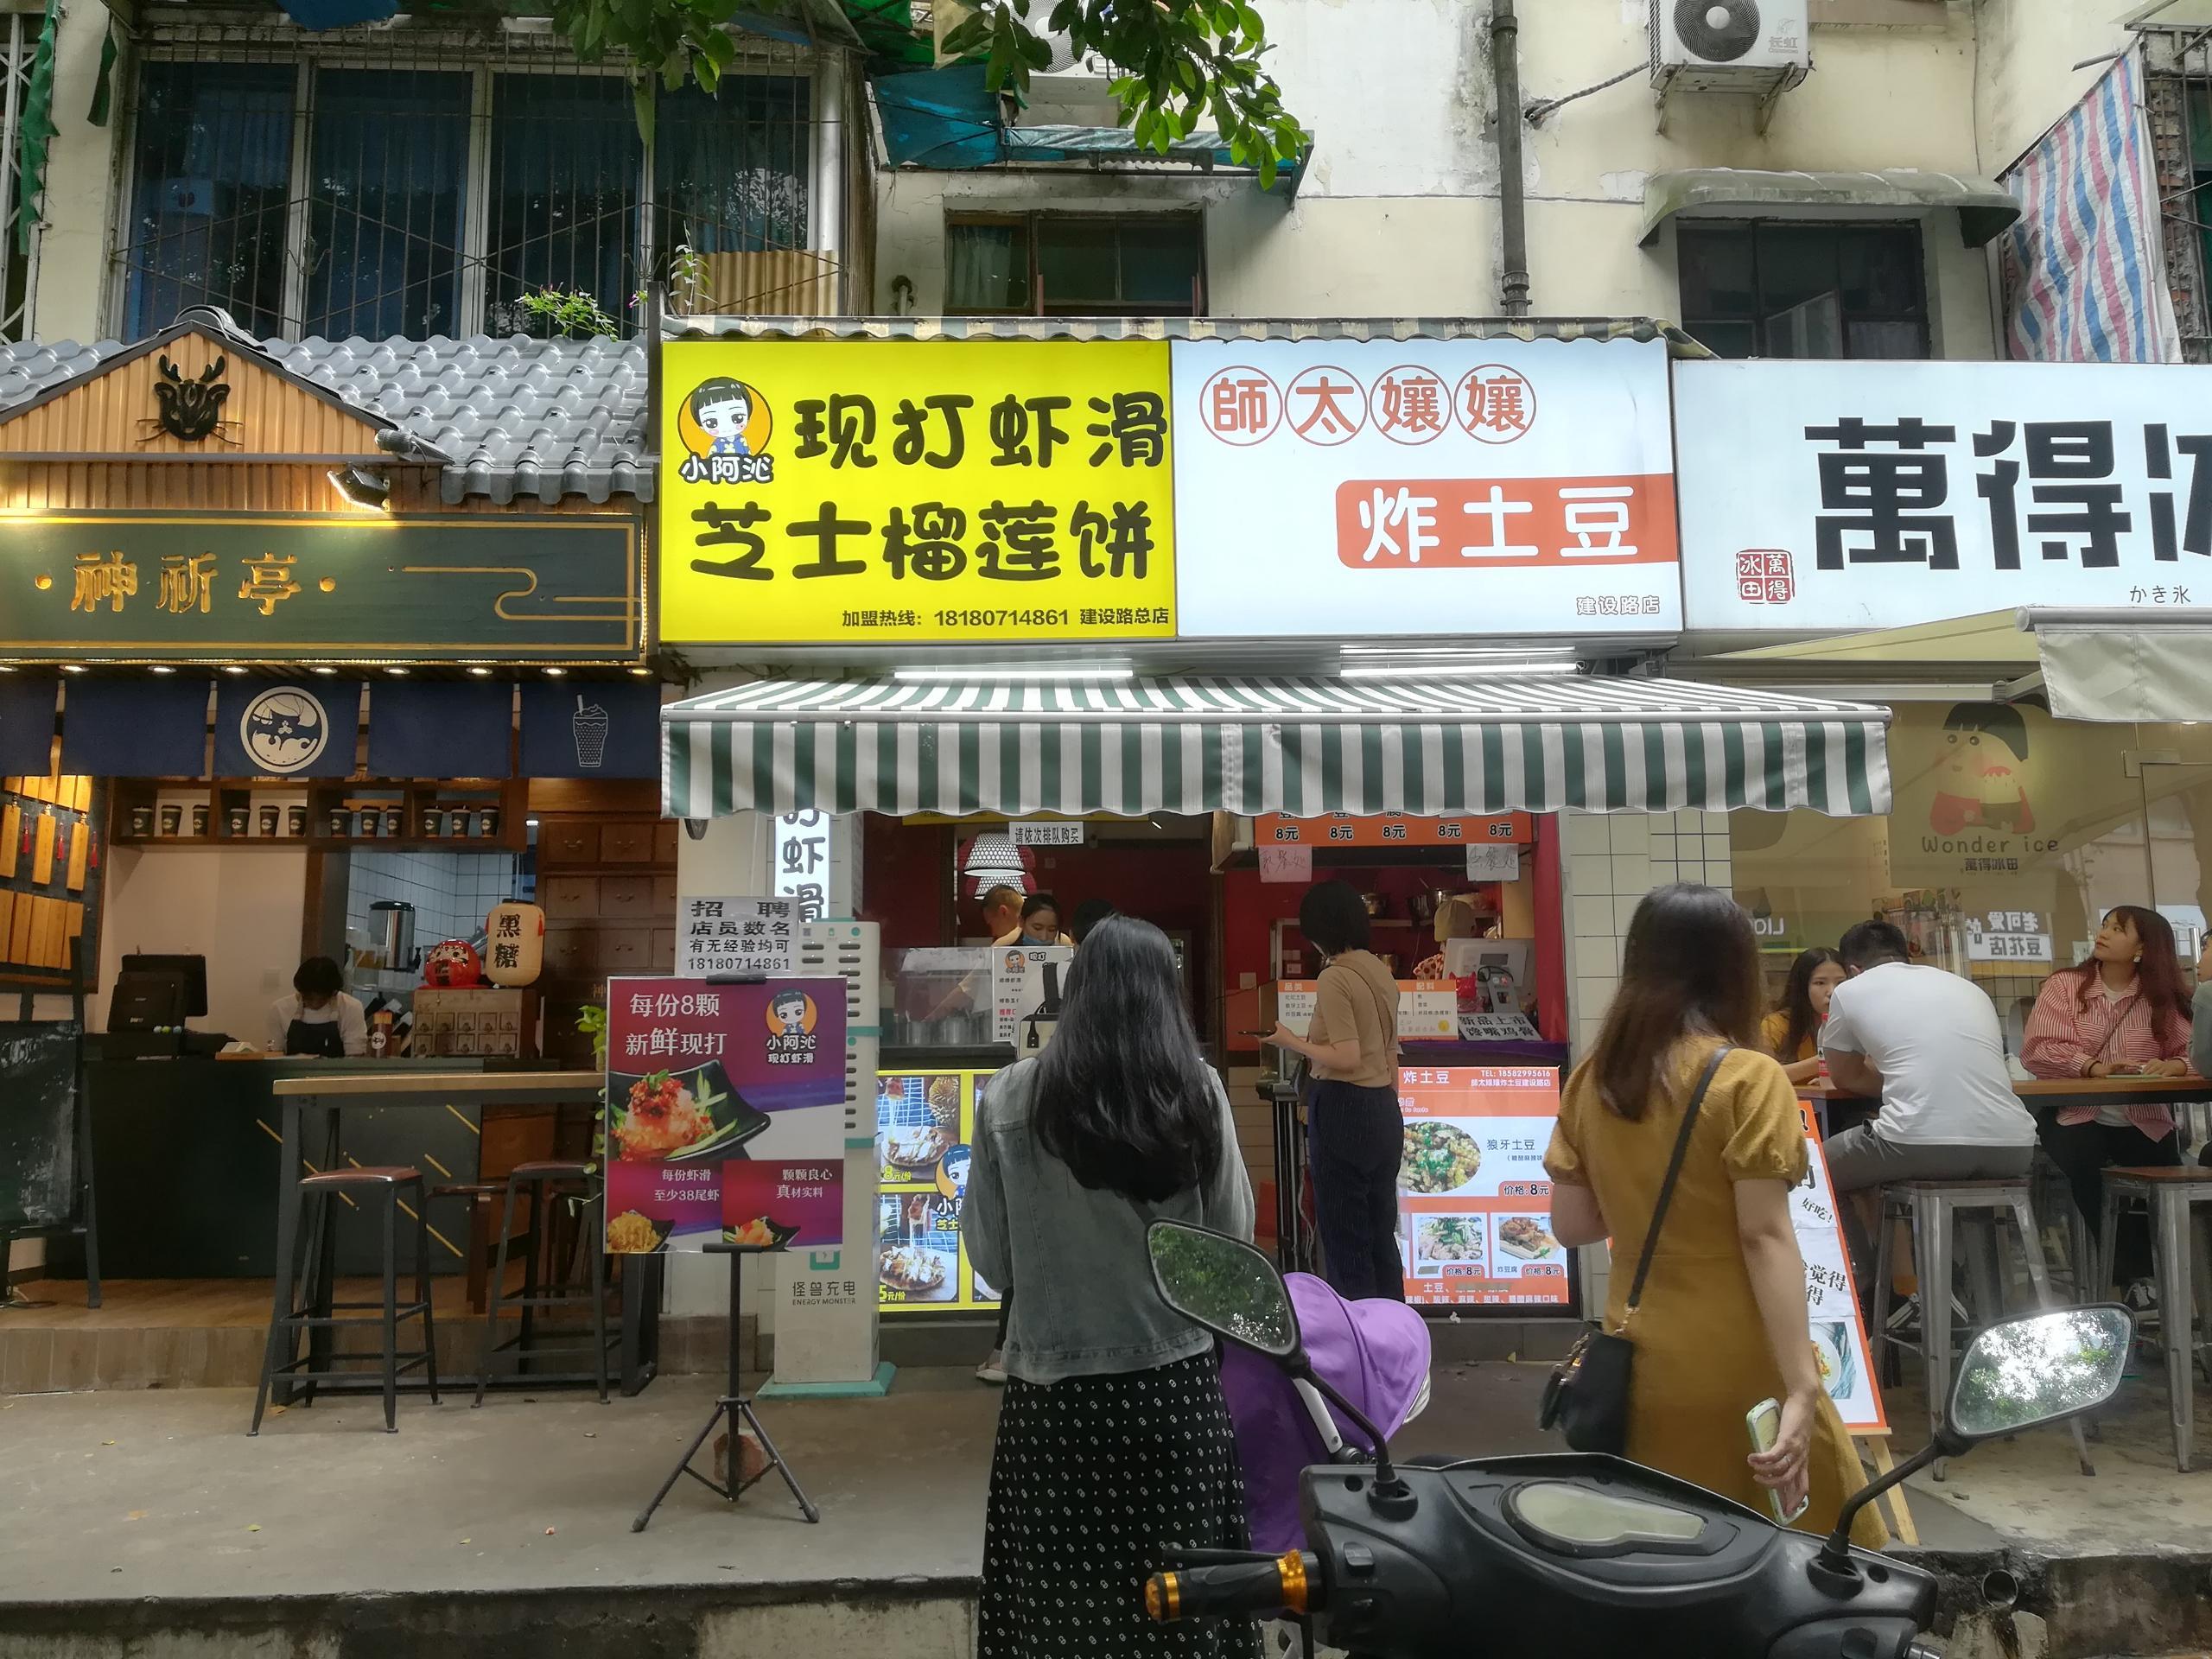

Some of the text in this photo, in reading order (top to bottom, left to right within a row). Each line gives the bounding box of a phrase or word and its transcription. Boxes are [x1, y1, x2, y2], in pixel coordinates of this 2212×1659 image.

[1212, 375, 1527, 434] 師太孃孃
[793, 391, 1167, 469] 现打虾滑
[680, 454, 773, 483] 小阿沁
[1359, 486, 1637, 563] 炸土豆
[690, 499, 1155, 581] 芝士榴莲饼
[71, 550, 301, 616] 神祈亭
[1577, 595, 1660, 615] 建设路店
[842, 607, 1170, 627] 加盟热线： 18180714861 建设路总店
[1015, 827, 1079, 843] 请依次排队购买
[1275, 827, 1299, 840] 8元
[1330, 826, 1353, 839] 8元
[1383, 825, 1406, 839] 8元
[1438, 824, 1461, 837] 8元
[1490, 823, 1512, 837] 8元
[1922, 836, 2059, 853] Wonder ice
[690, 921, 791, 936] 店员数名
[690, 938, 790, 953] 有无经验均可
[688, 957, 790, 970] 18180714861
[630, 993, 721, 1018] 每份8颗
[626, 1027, 728, 1056] 新鲜现打
[766, 1034, 817, 1051] 小阿沁
[1403, 1070, 1450, 1084] 炸土豆
[1498, 1069, 1551, 1077] 18582995616
[1486, 1139, 1535, 1151] 狼牙土豆
[662, 1168, 712, 1181] 每份虾滑
[782, 1168, 833, 1180] 颗颗良心
[654, 1188, 720, 1202] 至少38尾虾
[777, 1184, 823, 1199] 真材实料
[792, 1281, 855, 1297] 怪兽充电
